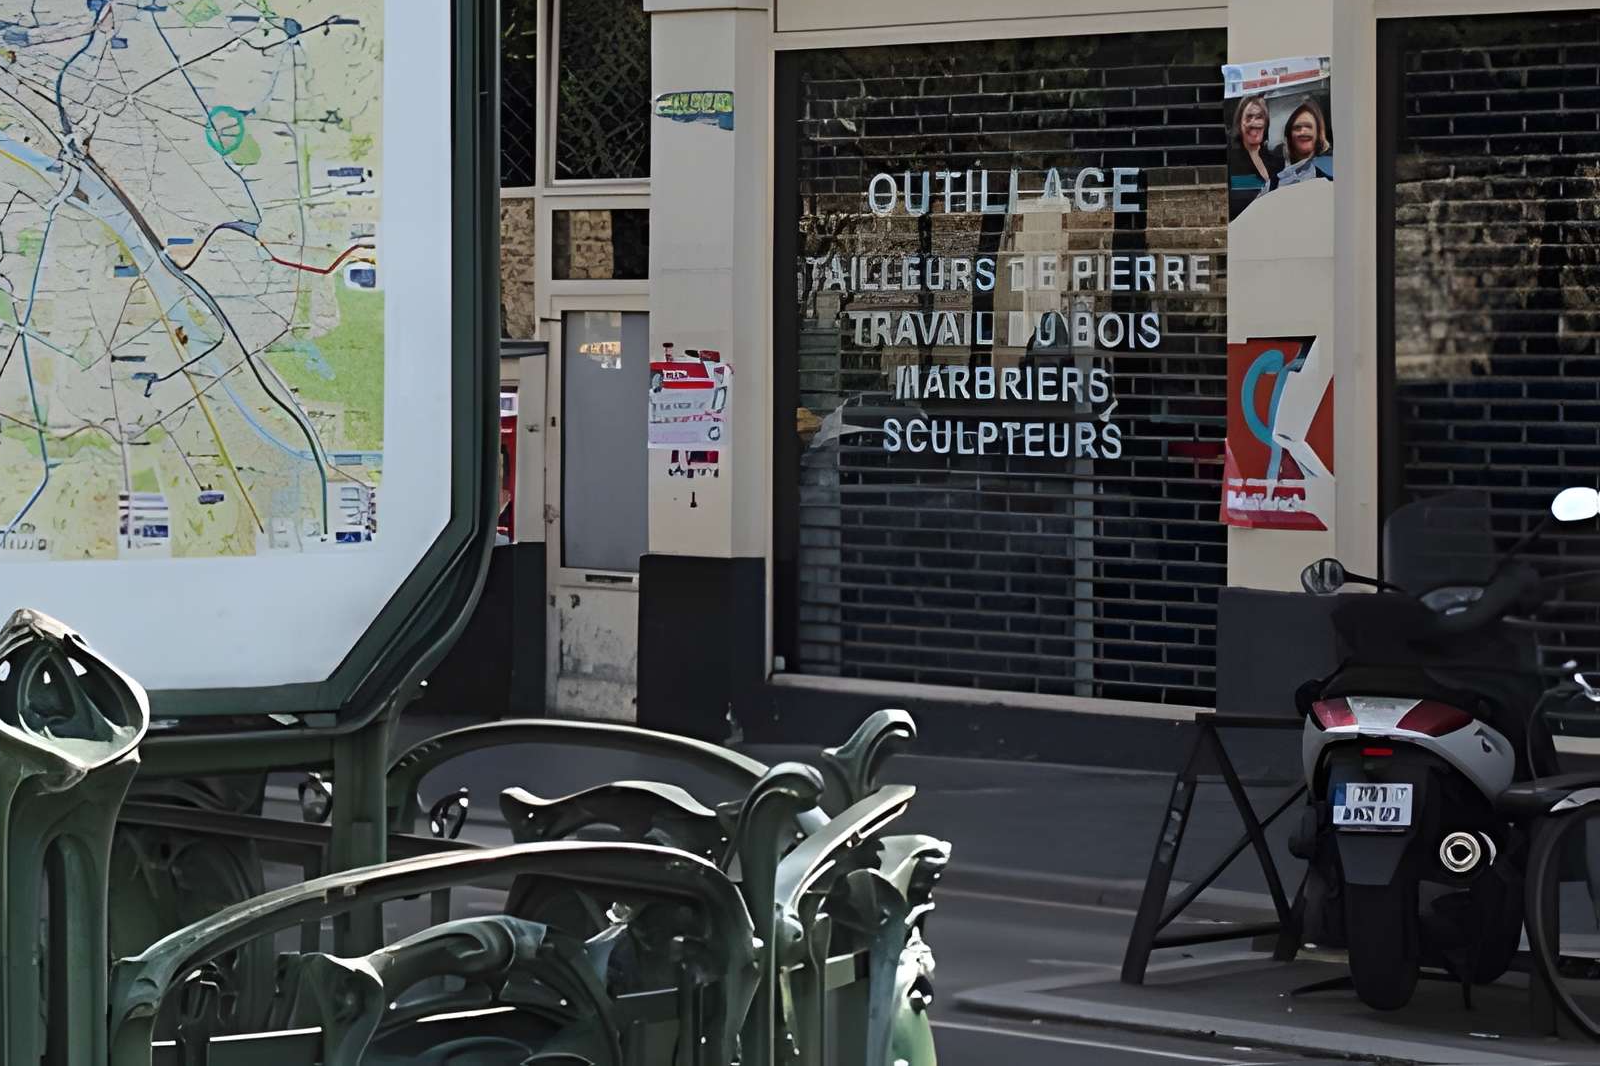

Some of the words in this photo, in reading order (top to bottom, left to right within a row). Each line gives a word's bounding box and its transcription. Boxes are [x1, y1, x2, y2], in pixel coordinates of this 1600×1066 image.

[868, 167, 1141, 216] OUTILLAGE
[805, 254, 997, 294] TAILLEURS
[1072, 254, 1211, 292] PIERRE
[850, 310, 994, 348] TRAVAIL
[1072, 310, 1162, 349] BOIS
[896, 365, 1109, 403] MARBRIERS
[883, 418, 1123, 460] SCULPTEURS
